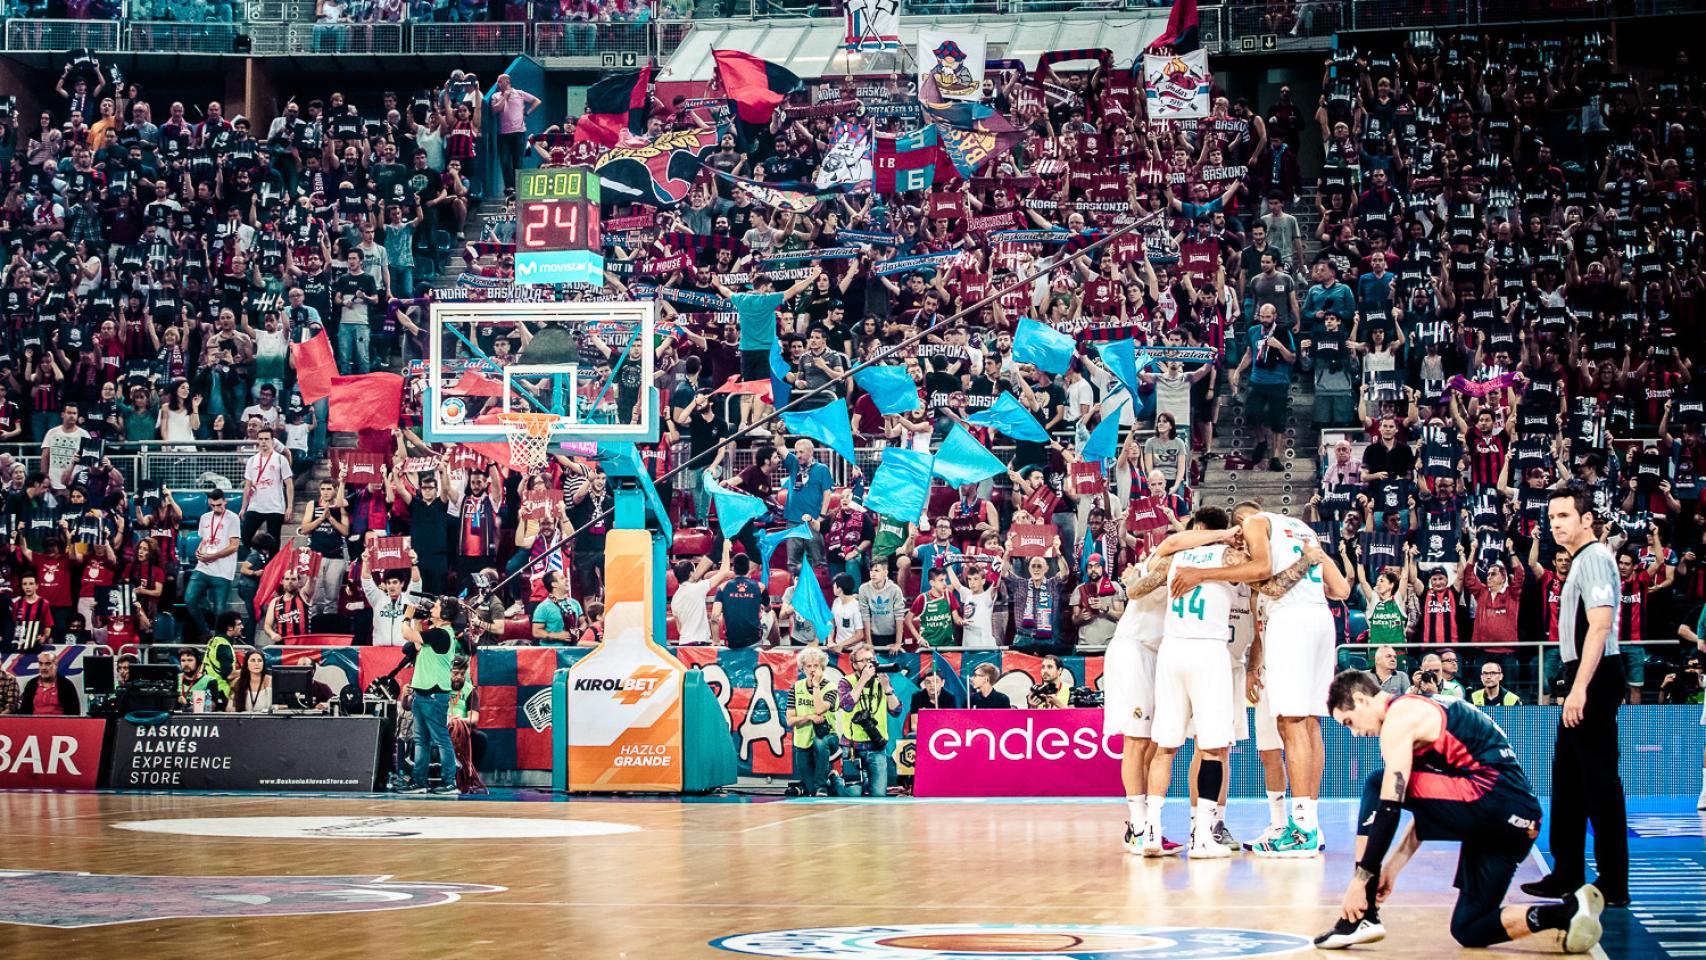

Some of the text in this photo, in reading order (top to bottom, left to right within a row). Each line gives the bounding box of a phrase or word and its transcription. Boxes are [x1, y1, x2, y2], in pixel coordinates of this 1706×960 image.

[529, 173, 582, 196] 10:00
[526, 205, 577, 246] 24
[540, 262, 586, 273] movistar
[607, 256, 682, 273] NOT IN MY HOUSE
[435, 287, 468, 300] INDAR
[487, 287, 541, 300] BASKONIA
[1172, 585, 1205, 621] 44
[1229, 608, 1250, 616] rsidad
[574, 678, 659, 691] KIROLBET
[135, 725, 220, 738] BASKONIA
[133, 738, 198, 753] ALAVÉS
[620, 744, 666, 756] HAZLO
[132, 756, 232, 769] EXPERIENCE
[613, 756, 672, 767] GRANDE
[130, 771, 181, 785] STORE
